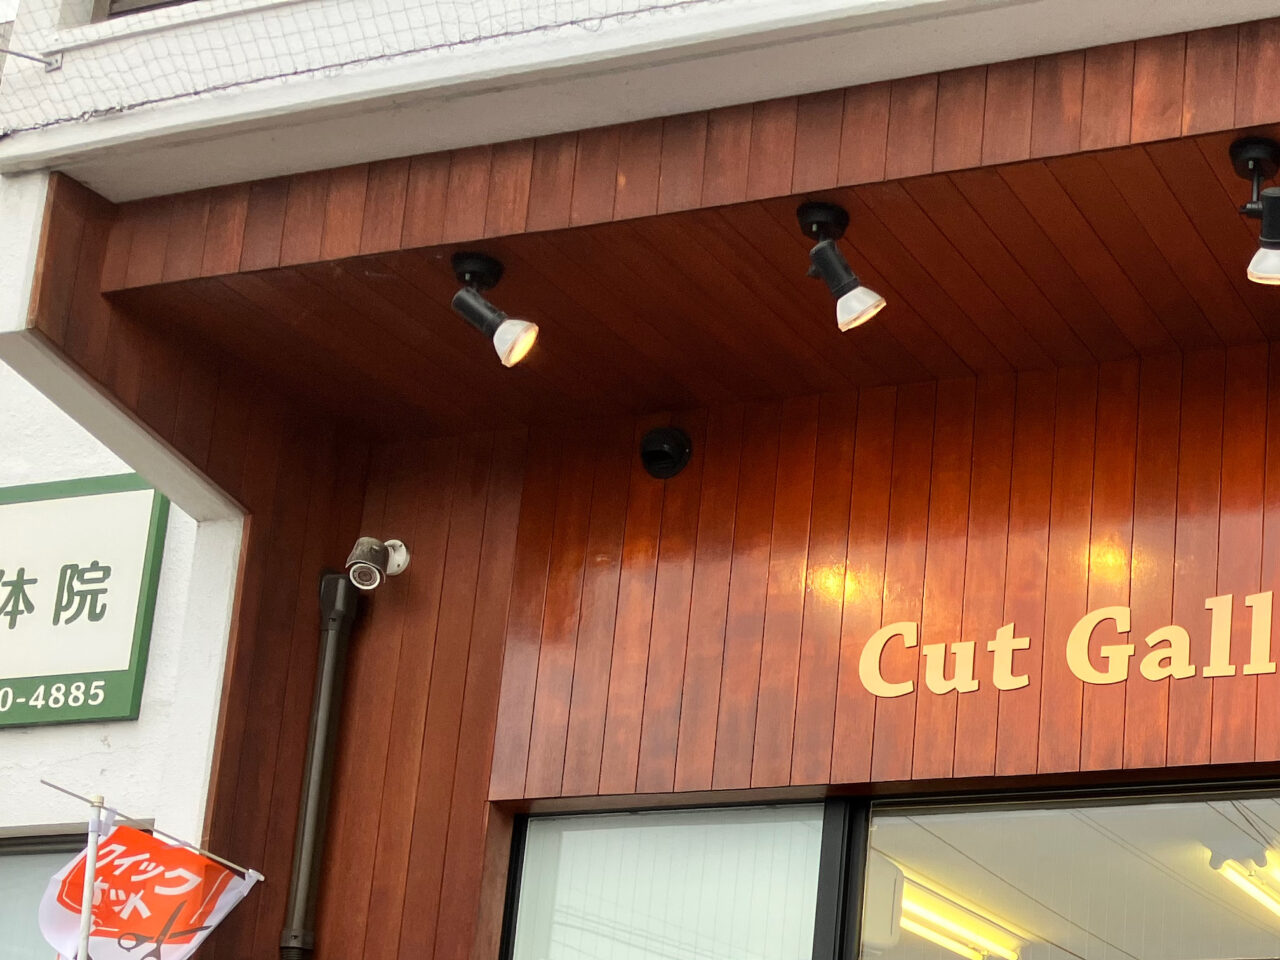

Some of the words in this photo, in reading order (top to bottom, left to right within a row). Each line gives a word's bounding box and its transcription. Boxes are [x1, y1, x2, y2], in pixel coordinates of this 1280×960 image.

[0, 560, 111, 629] 体院
[858, 621, 1031, 698] Cut
[0, 680, 105, 712] 0-4885
